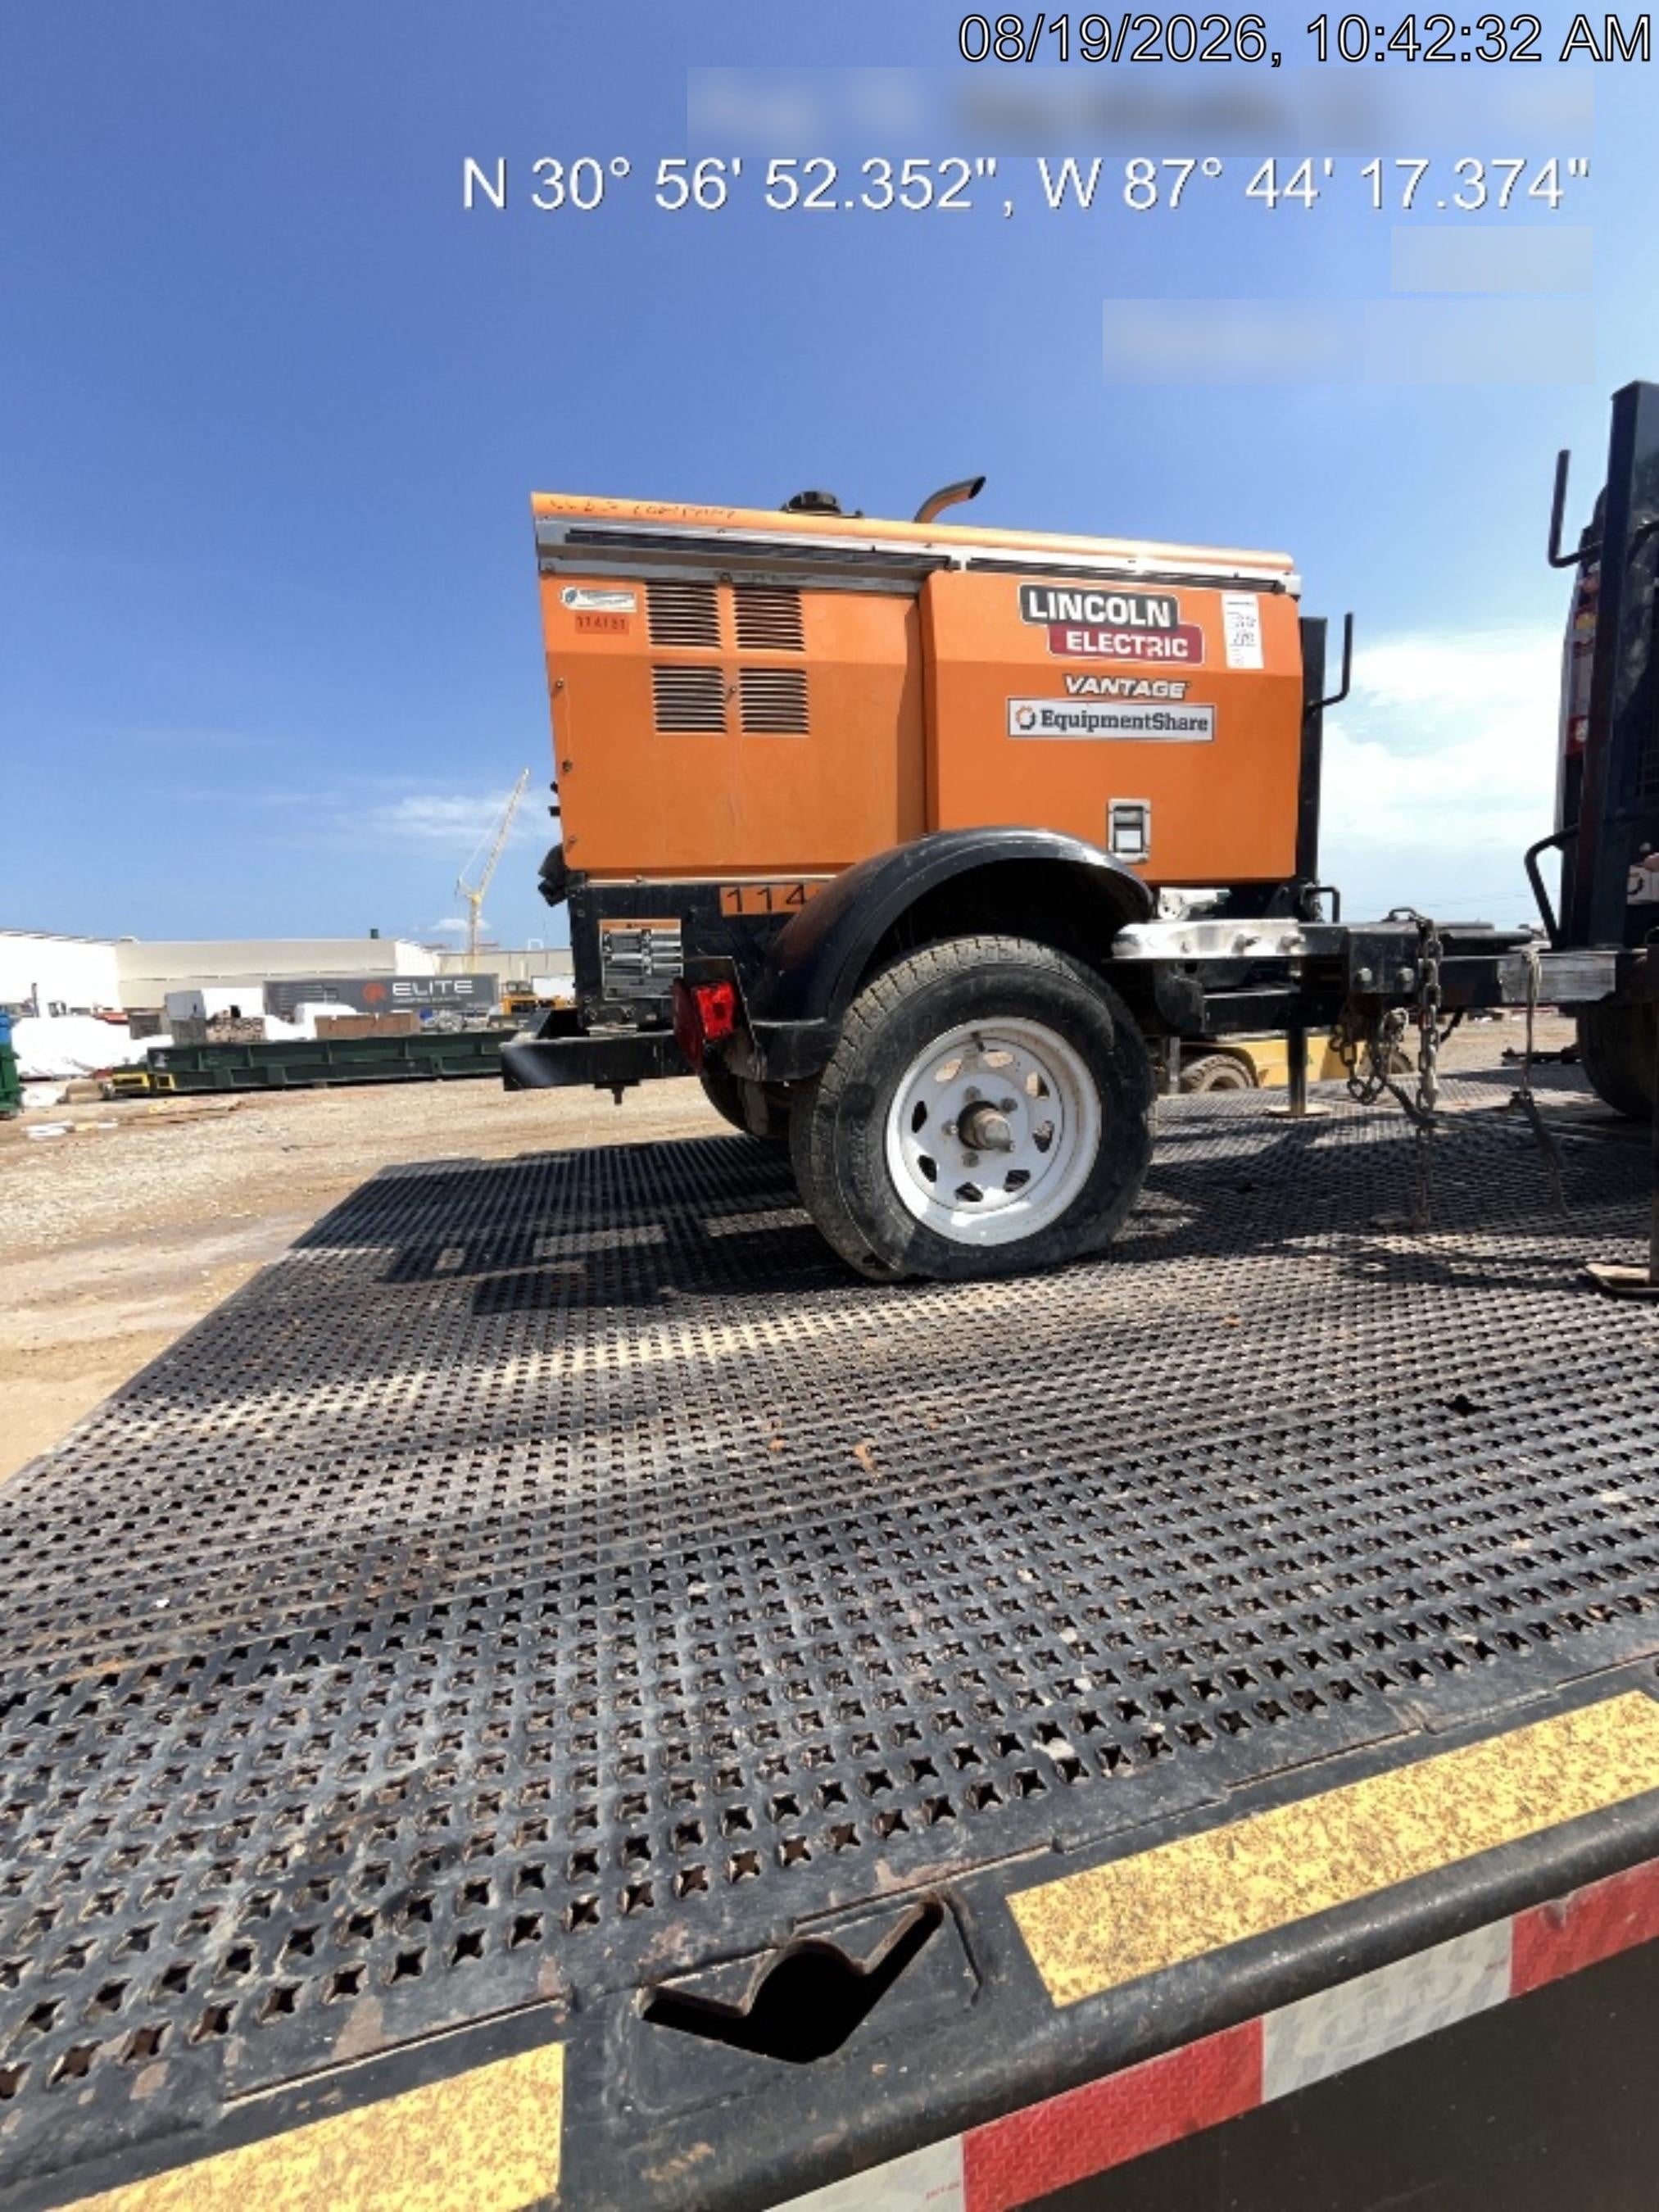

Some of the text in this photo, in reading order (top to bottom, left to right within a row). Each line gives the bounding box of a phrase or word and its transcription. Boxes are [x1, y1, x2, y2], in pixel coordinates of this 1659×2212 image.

[1029, 590, 1172, 628] LINCOLN
[1066, 630, 1189, 658] ELECTRIC
[1064, 674, 1188, 700] VANTAGE
[1040, 709, 1208, 732] EquipmentShare
[727, 884, 821, 913] 114
[392, 980, 474, 996] ELITE
